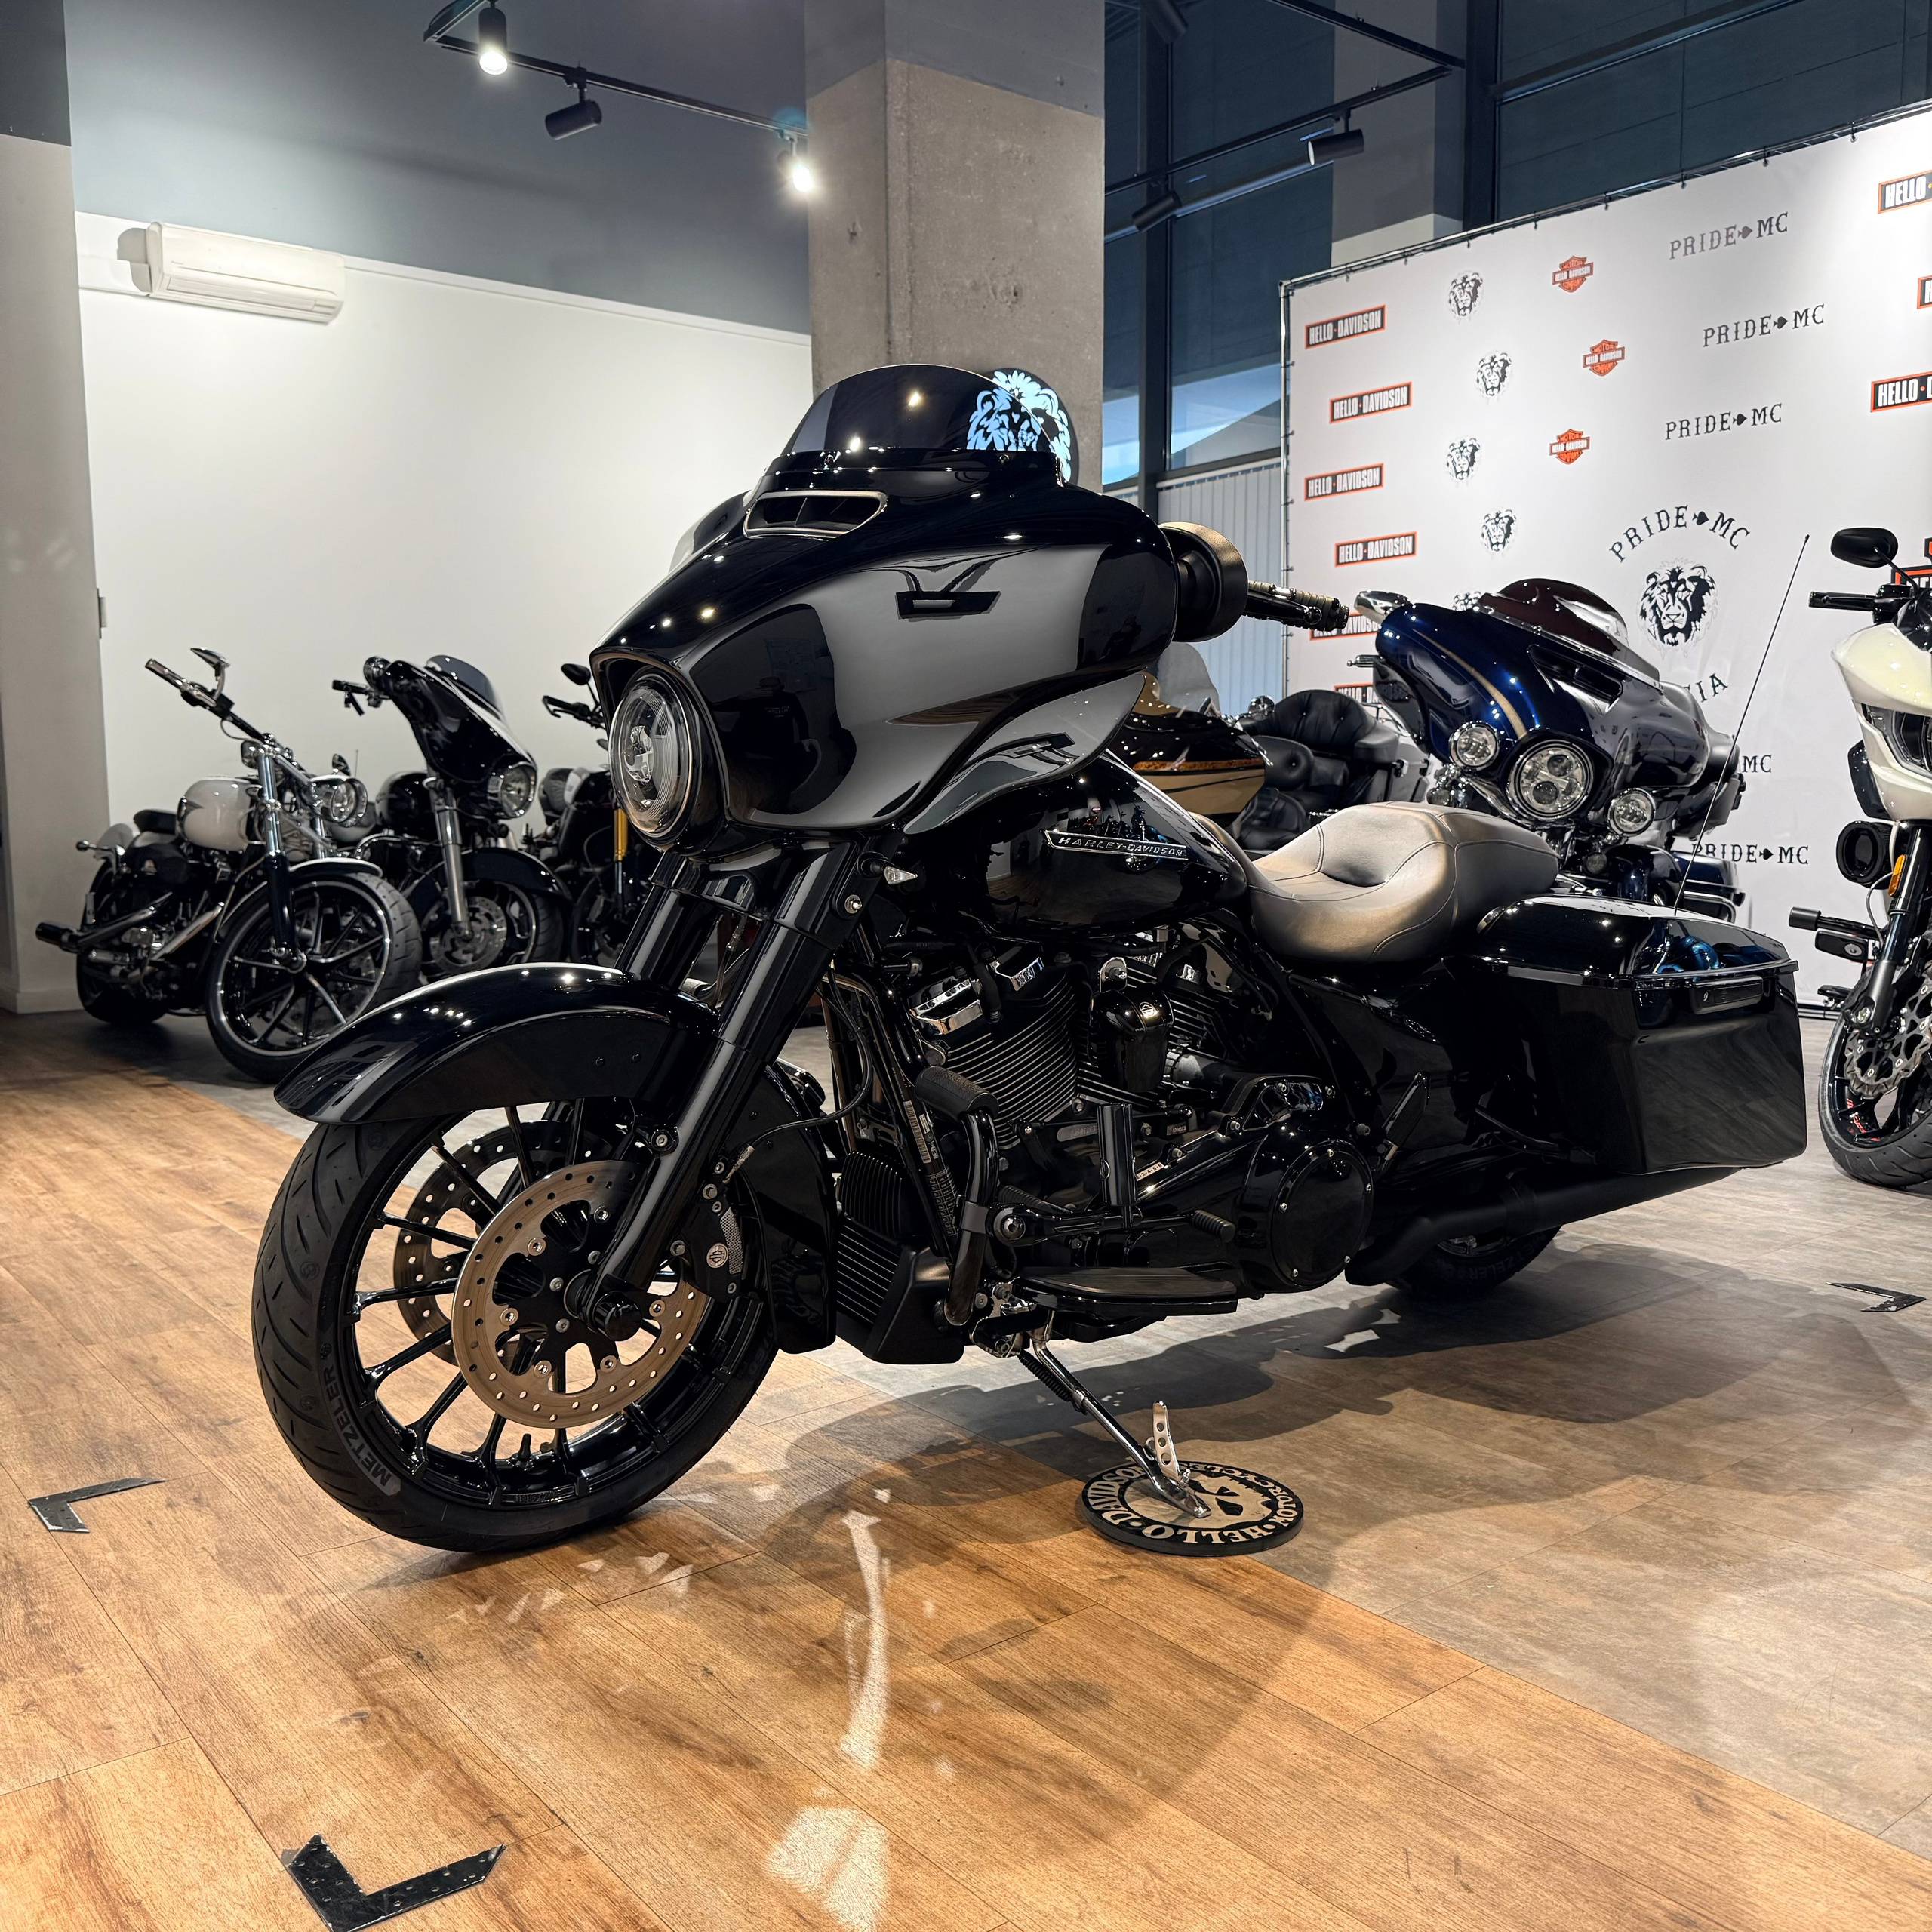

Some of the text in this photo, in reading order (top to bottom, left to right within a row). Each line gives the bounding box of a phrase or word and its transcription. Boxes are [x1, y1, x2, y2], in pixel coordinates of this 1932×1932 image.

[1885, 175, 1927, 208] HELLO
[1669, 211, 1789, 260] PRIDE MC
[1309, 309, 1382, 345] HELLO DAVIDSON
[1703, 303, 1825, 347] PRIDE MC
[1333, 386, 1408, 420] HELLO DAVIDSON
[1878, 378, 1918, 407] HELLO
[1665, 402, 1782, 440] PRIDE MC
[1308, 466, 1380, 497] HELLO DAVIDSON
[1338, 535, 1413, 564] HELLO DAVIDSON
[1609, 504, 1751, 563] PRIDE MC
[1742, 754, 1772, 773] MC
[1058, 837, 1183, 857] HARLEY-DAVIDSON
[1777, 845, 1809, 865] MC
[323, 1364, 392, 1487] METZELER
[1142, 1524, 1274, 1544] HELLO
